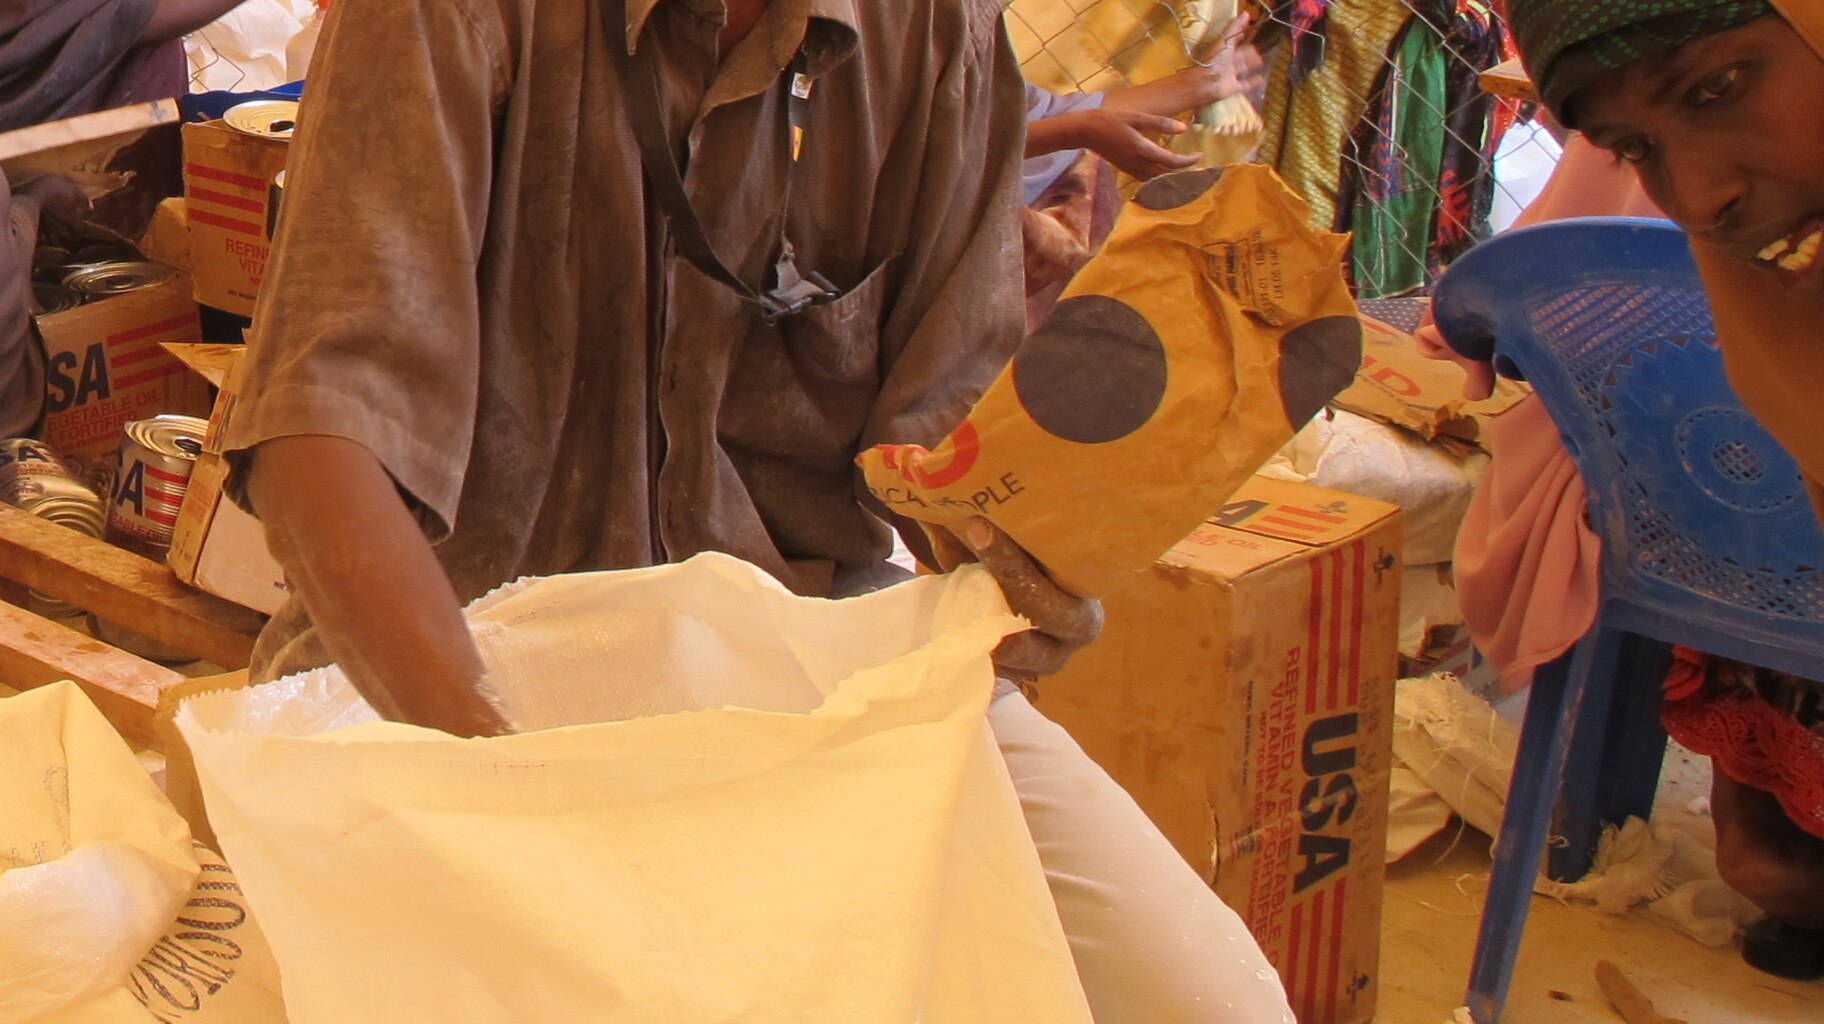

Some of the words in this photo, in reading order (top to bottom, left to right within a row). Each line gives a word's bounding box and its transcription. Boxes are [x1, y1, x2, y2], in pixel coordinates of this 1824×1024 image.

[47, 342, 110, 413] SA
[1265, 684, 1284, 792] VITAMIN
[1278, 645, 1301, 772] REFINED
[1264, 796, 1278, 817] A
[1268, 778, 1294, 944] VEGETABLE
[1292, 712, 1360, 895] USA
[1254, 829, 1278, 950] FORTIFIE
